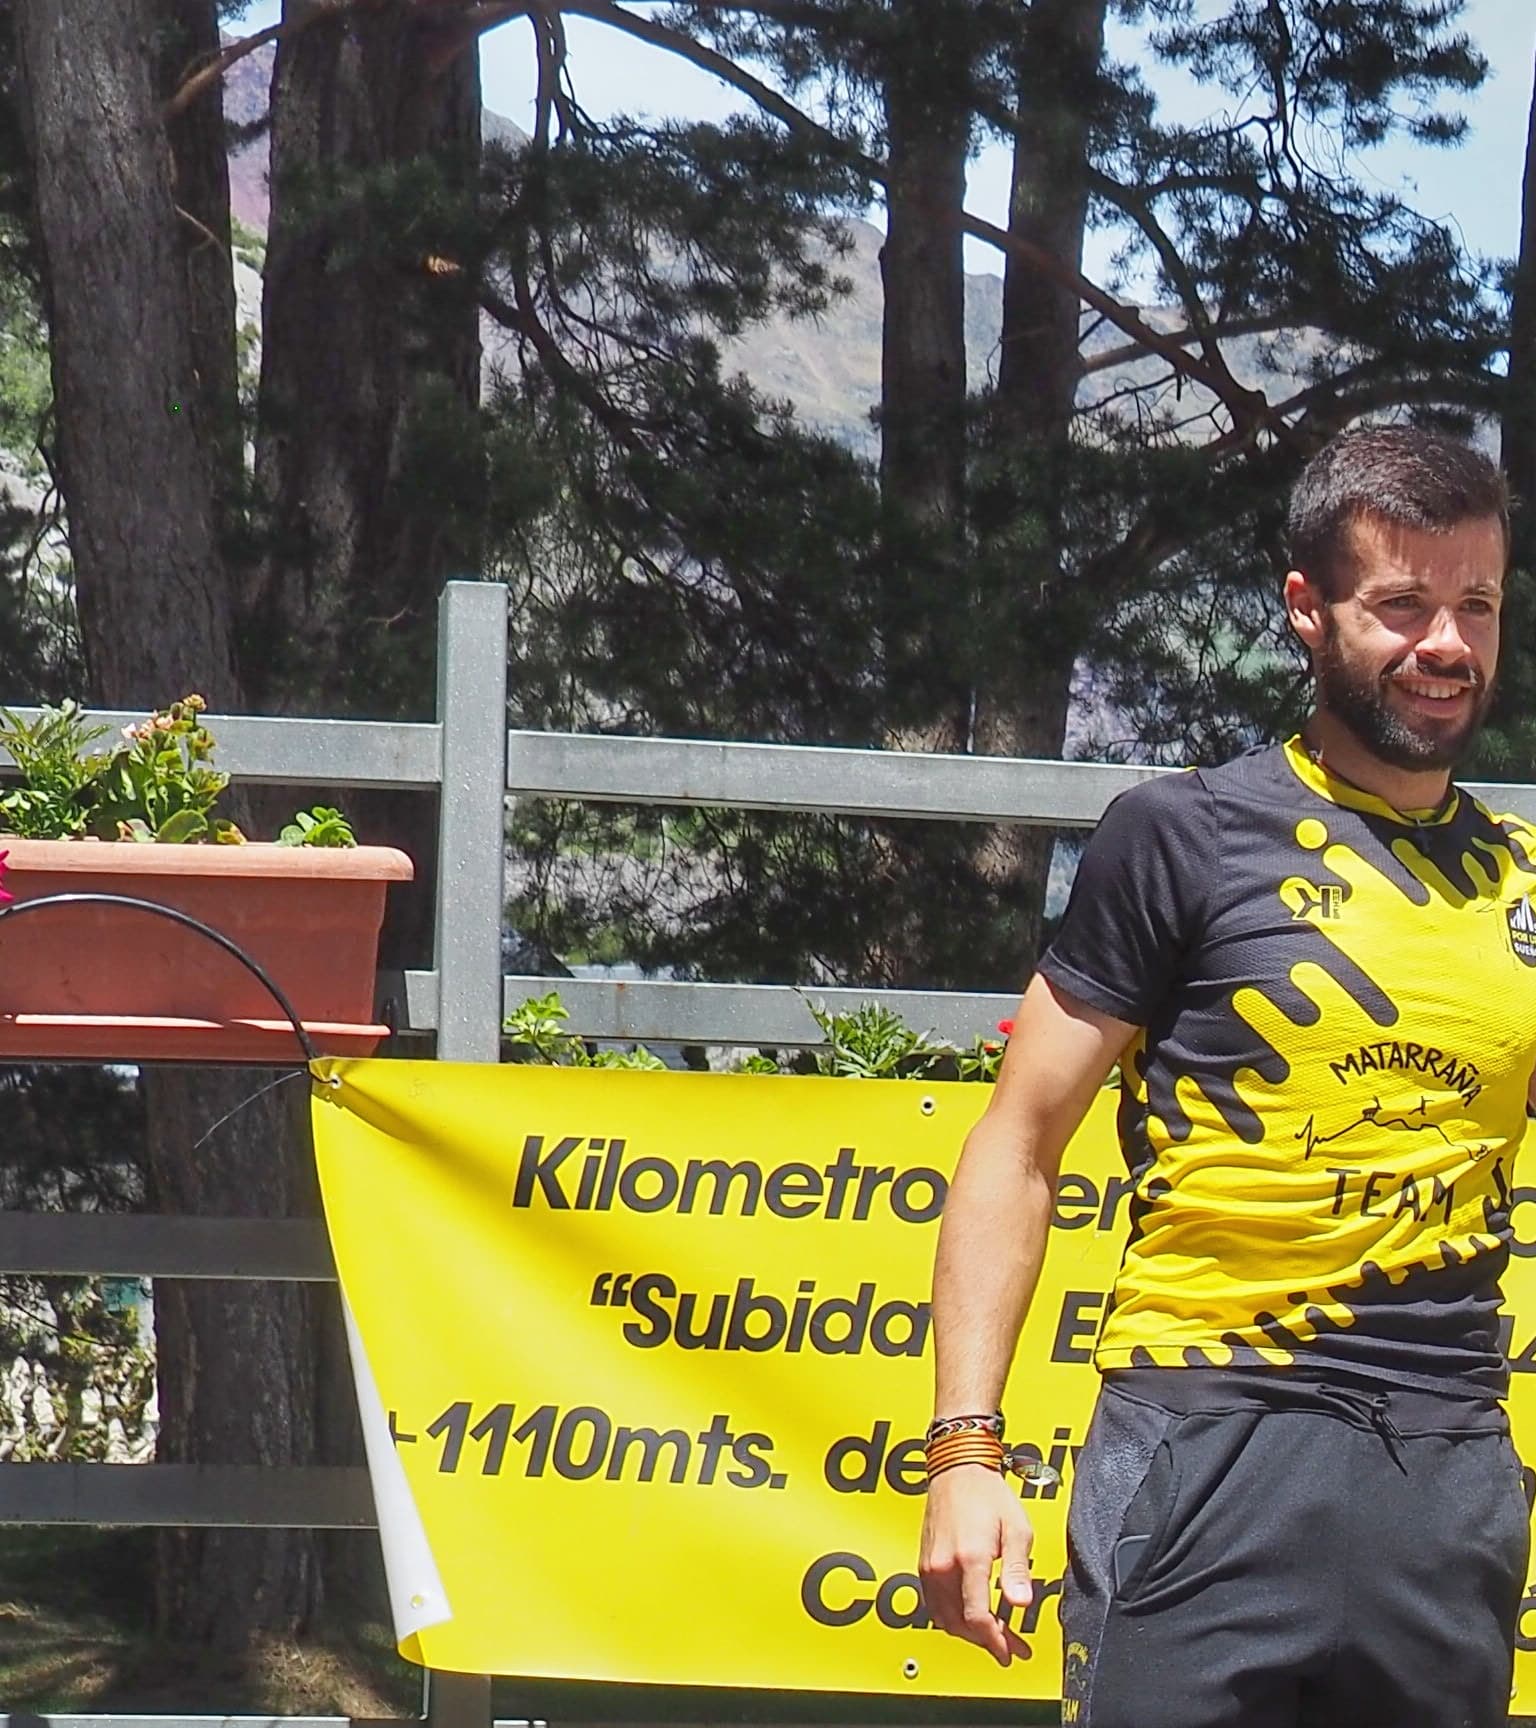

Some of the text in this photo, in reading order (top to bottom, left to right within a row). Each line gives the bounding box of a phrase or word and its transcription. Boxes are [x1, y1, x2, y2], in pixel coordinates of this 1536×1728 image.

[1329, 1041, 1482, 1107] MATARRAÑA
[511, 1135, 945, 1222] Kilometro
[1326, 1168, 1455, 1225] TEAM
